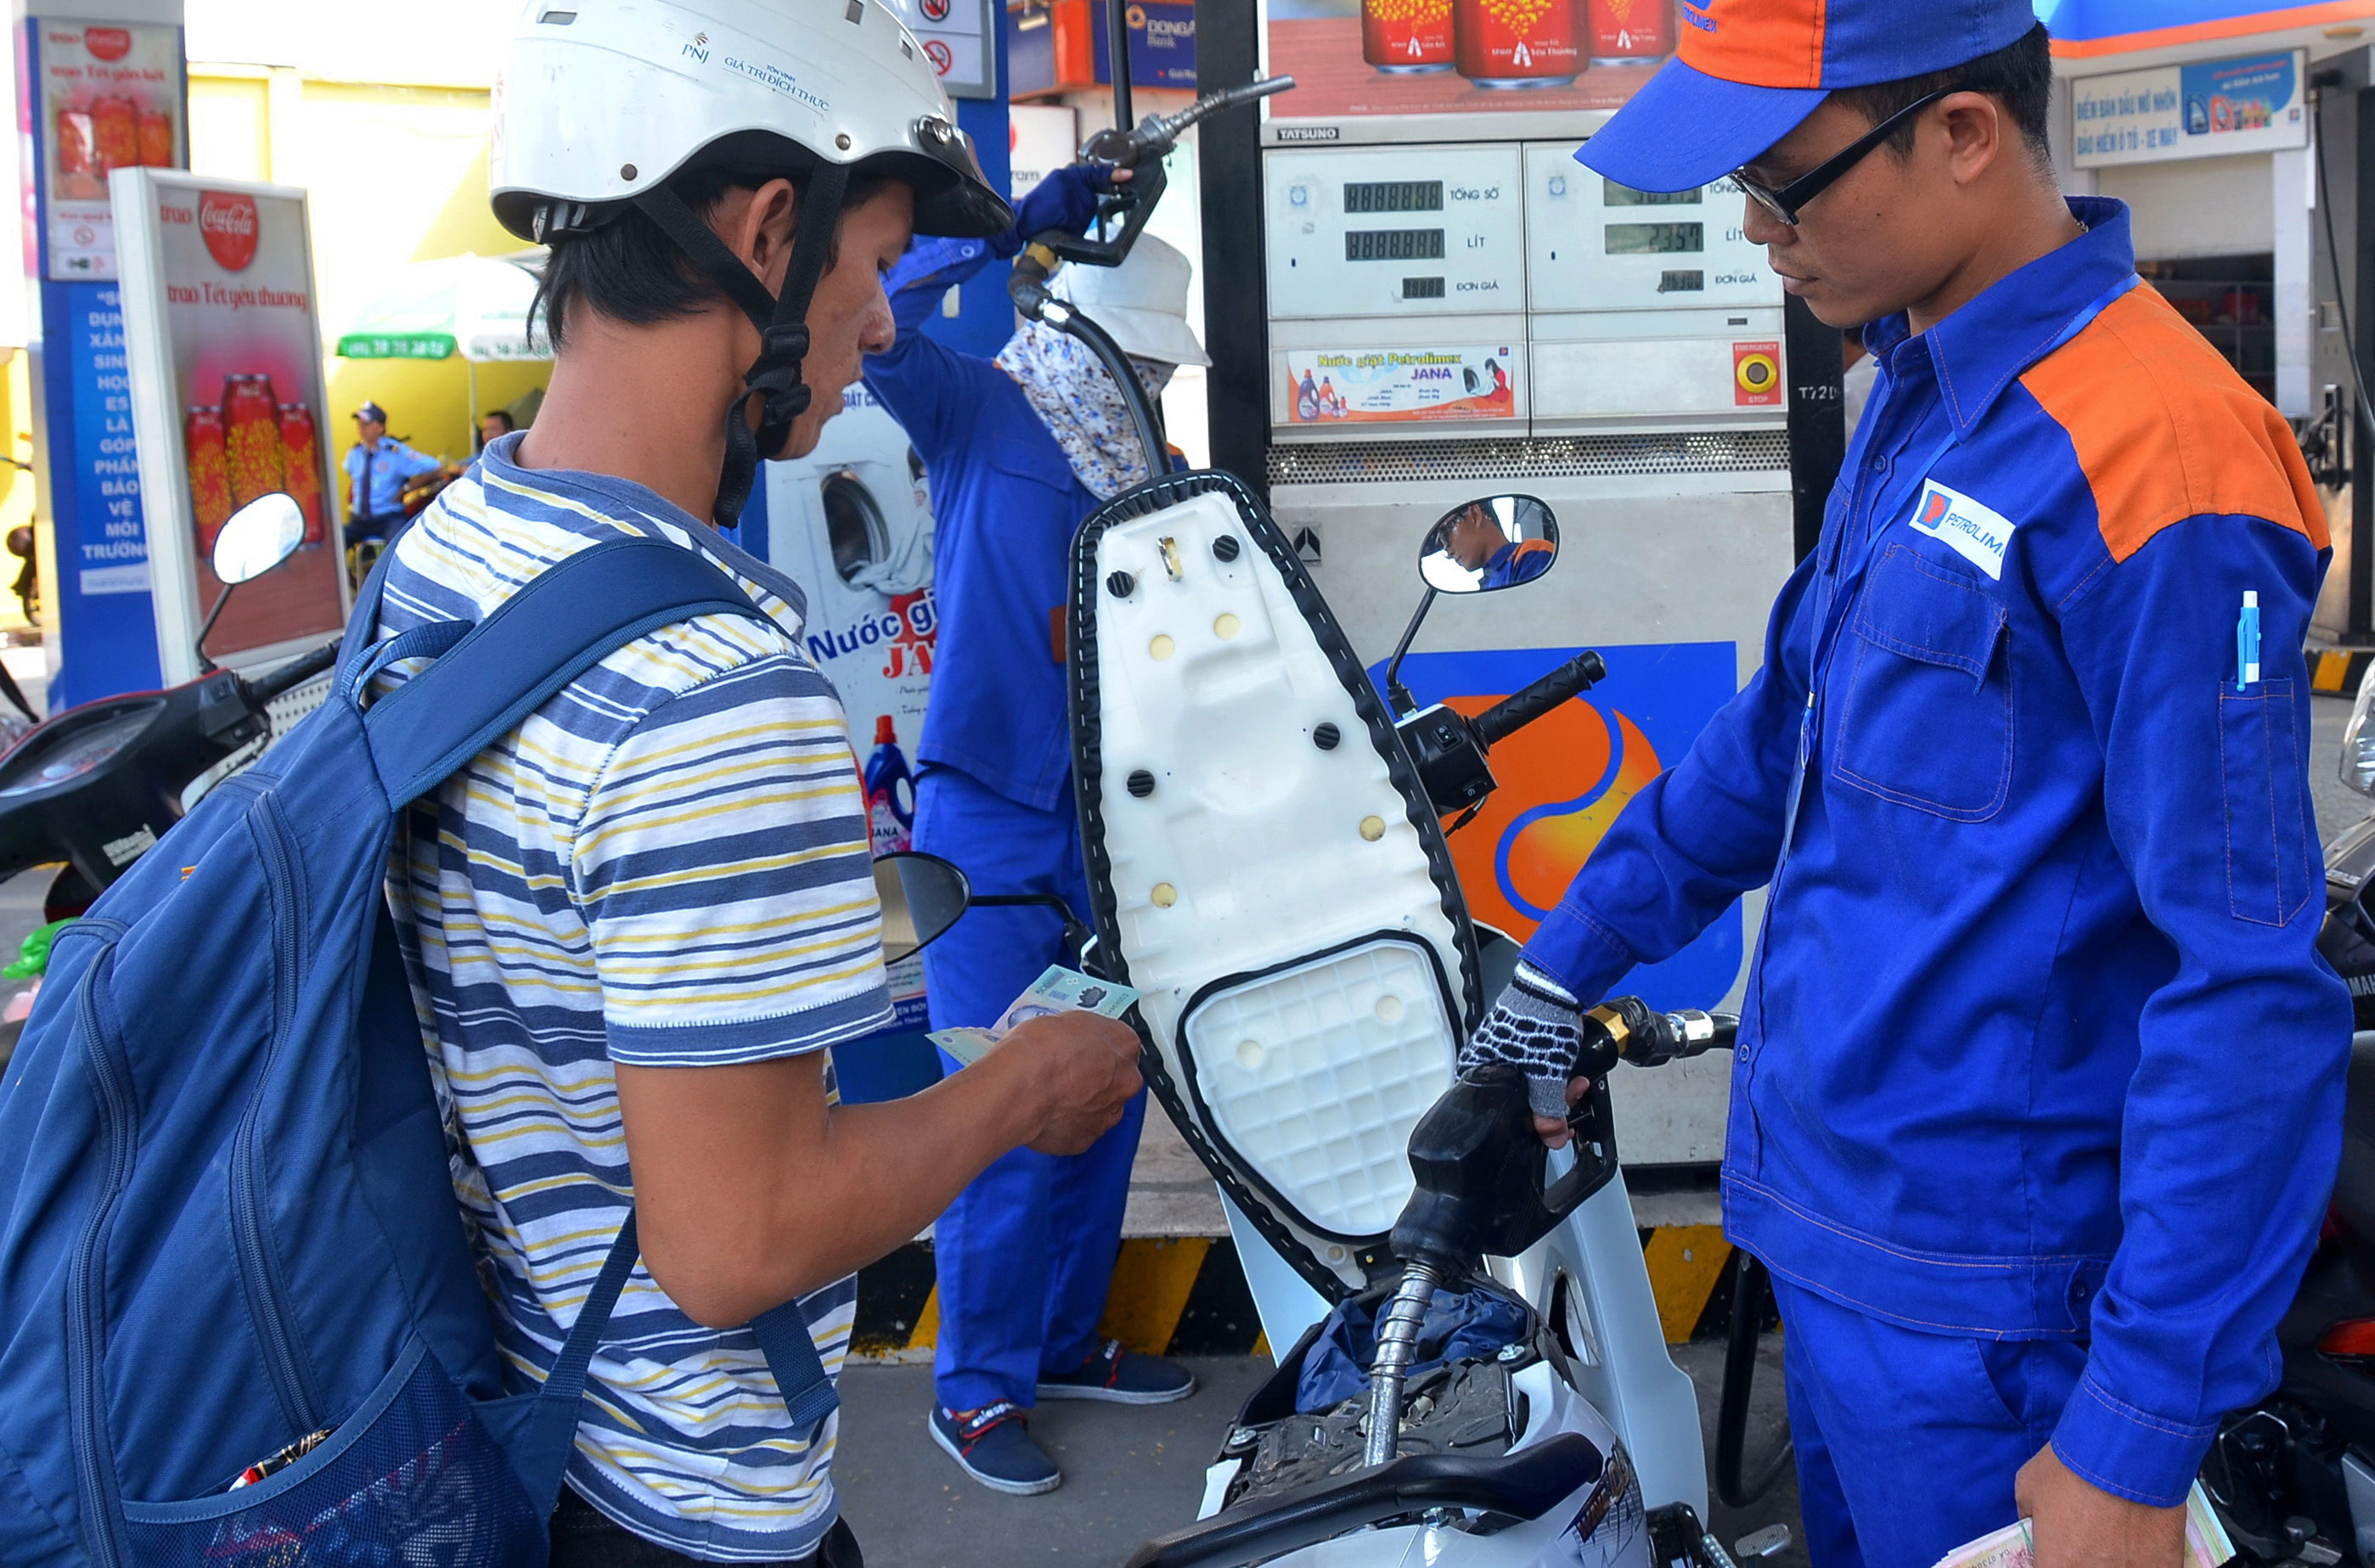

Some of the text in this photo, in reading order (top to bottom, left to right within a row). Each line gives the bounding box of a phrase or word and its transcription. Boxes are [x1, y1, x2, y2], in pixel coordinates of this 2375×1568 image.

[682, 43, 710, 64] PNJ
[1280, 127, 1337, 139] TATSUNO
[1467, 234, 1486, 248] LÍT
[1481, 279, 1499, 290] GIÁ
[1388, 352, 1462, 366] Petrolimex
[1411, 368, 1453, 380] JANA
[1747, 396, 1769, 404] STOP
[807, 591, 938, 663] Nước gi
[882, 643, 932, 678] JA
[2342, 974, 2375, 997] MAH
